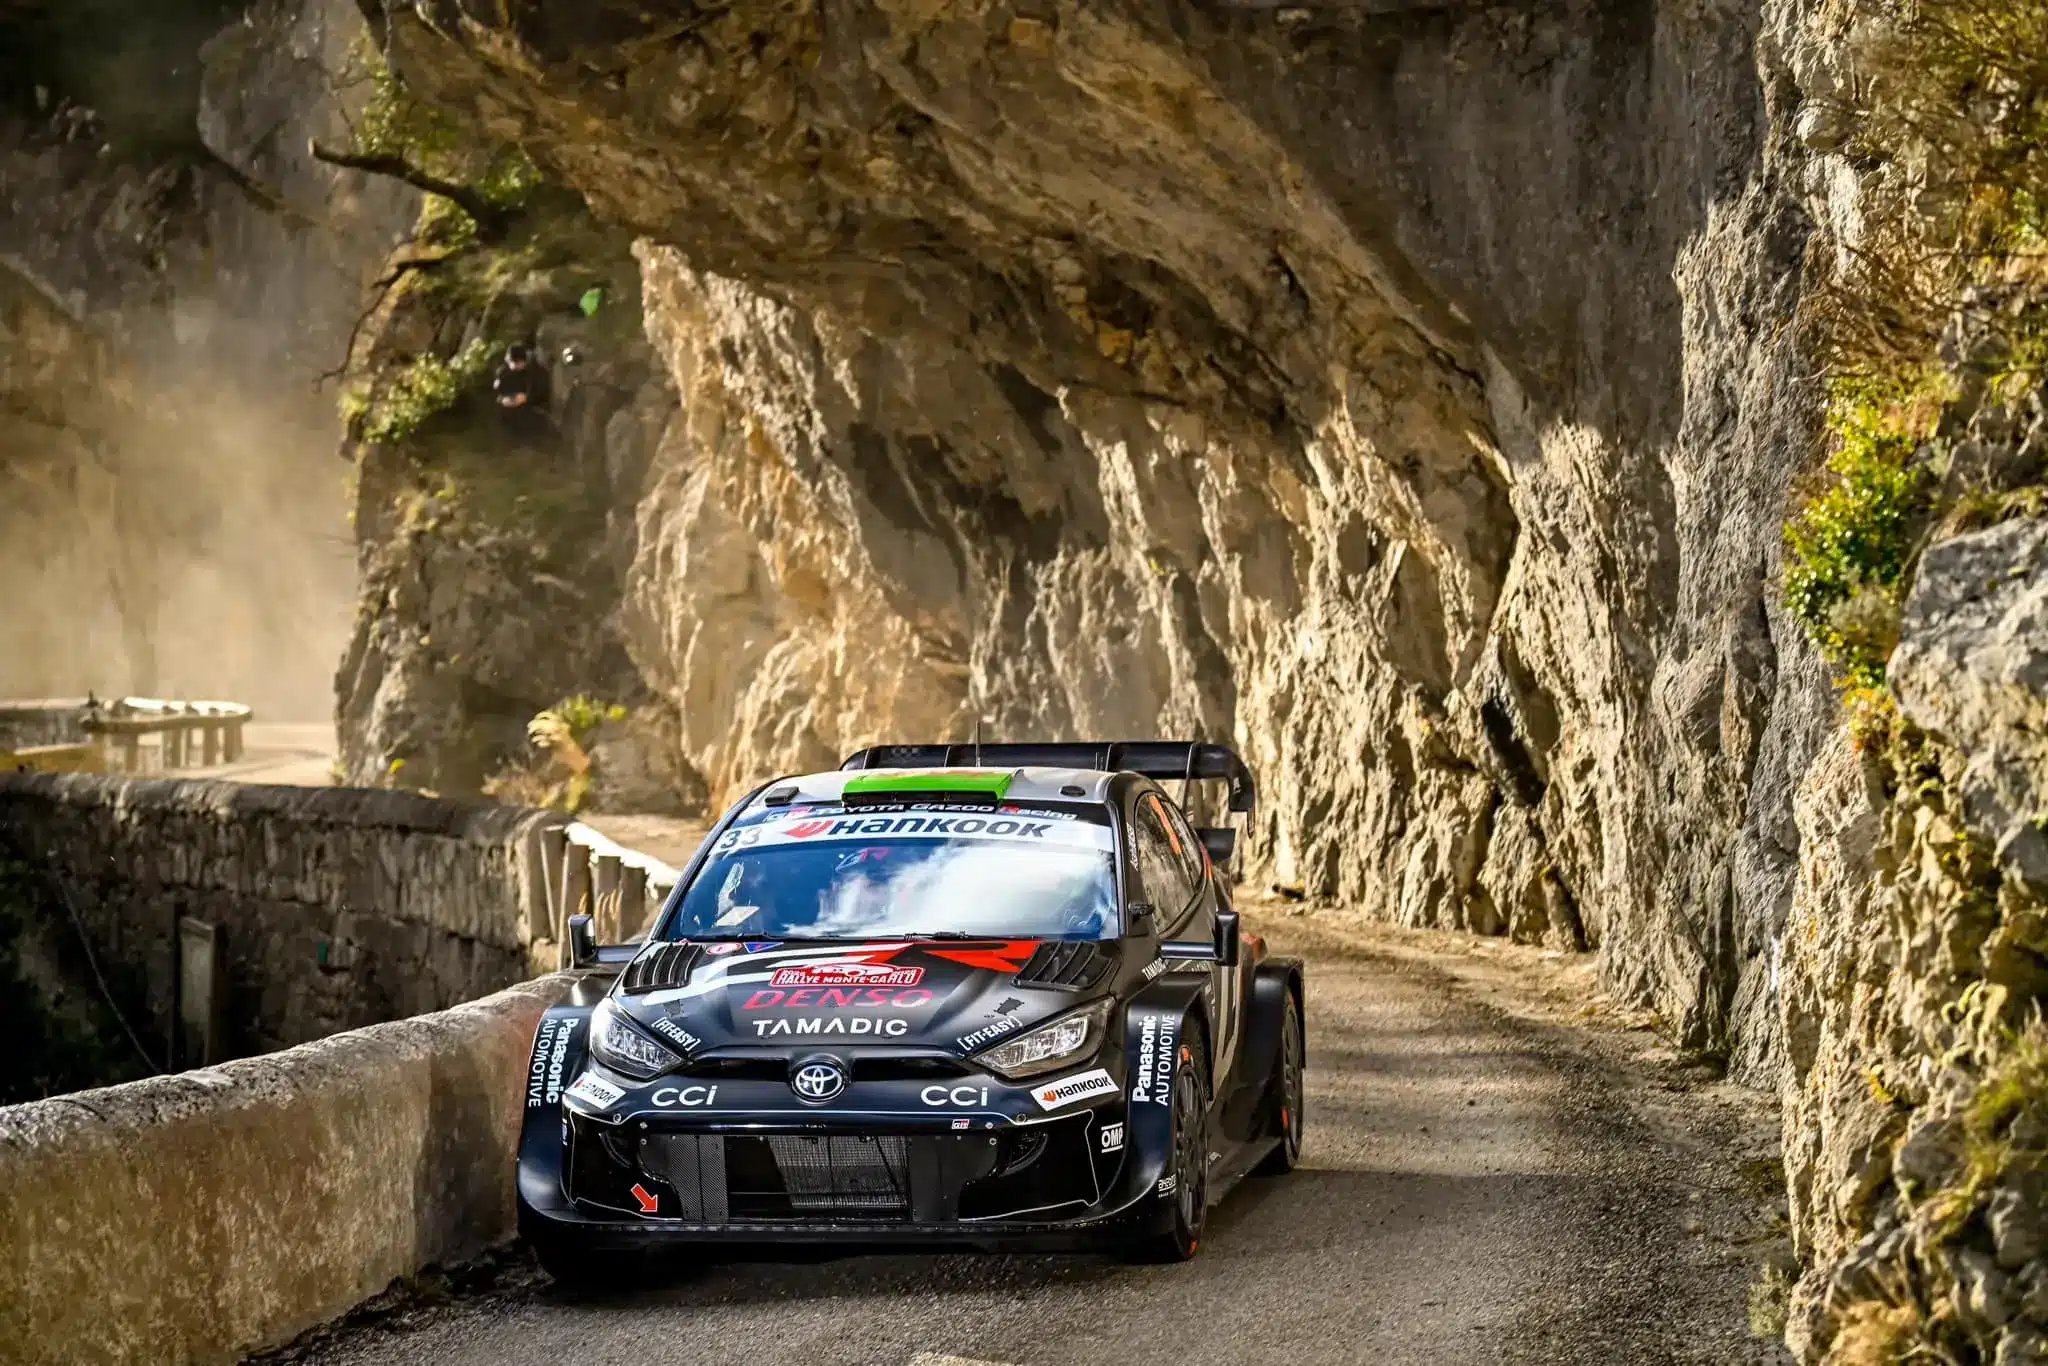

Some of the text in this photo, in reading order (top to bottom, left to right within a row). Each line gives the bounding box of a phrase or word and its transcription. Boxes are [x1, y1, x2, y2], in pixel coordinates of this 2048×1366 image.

[910, 803, 995, 813] GAZOO
[720, 829, 763, 849] 33
[776, 970, 820, 985] RALLYE
[743, 988, 934, 1010] DENSO
[752, 1018, 908, 1036] TAMADIC
[528, 1018, 555, 1108] AUTOMOTIVE
[545, 1017, 580, 1104] Panasonic
[1132, 1015, 1157, 1103] Panasonic
[1154, 1014, 1176, 1106] AUTOMOTIVE
[1101, 1126, 1124, 1148] OMP
